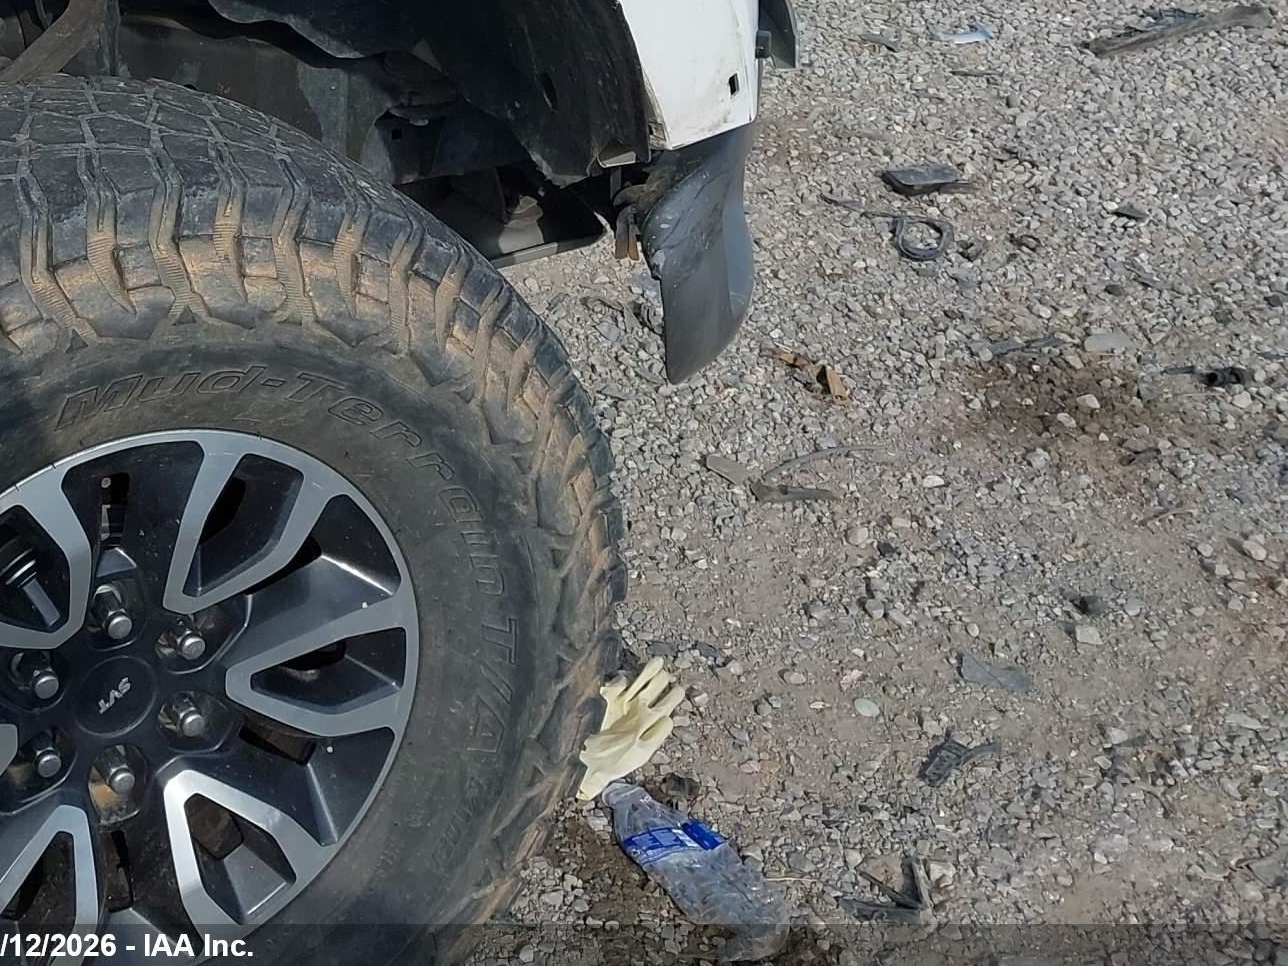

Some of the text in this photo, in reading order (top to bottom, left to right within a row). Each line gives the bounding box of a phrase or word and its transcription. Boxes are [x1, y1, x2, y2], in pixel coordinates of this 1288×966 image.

[54, 364, 519, 754] Mud-Terrain T/A
[97, 676, 131, 715] SVT
